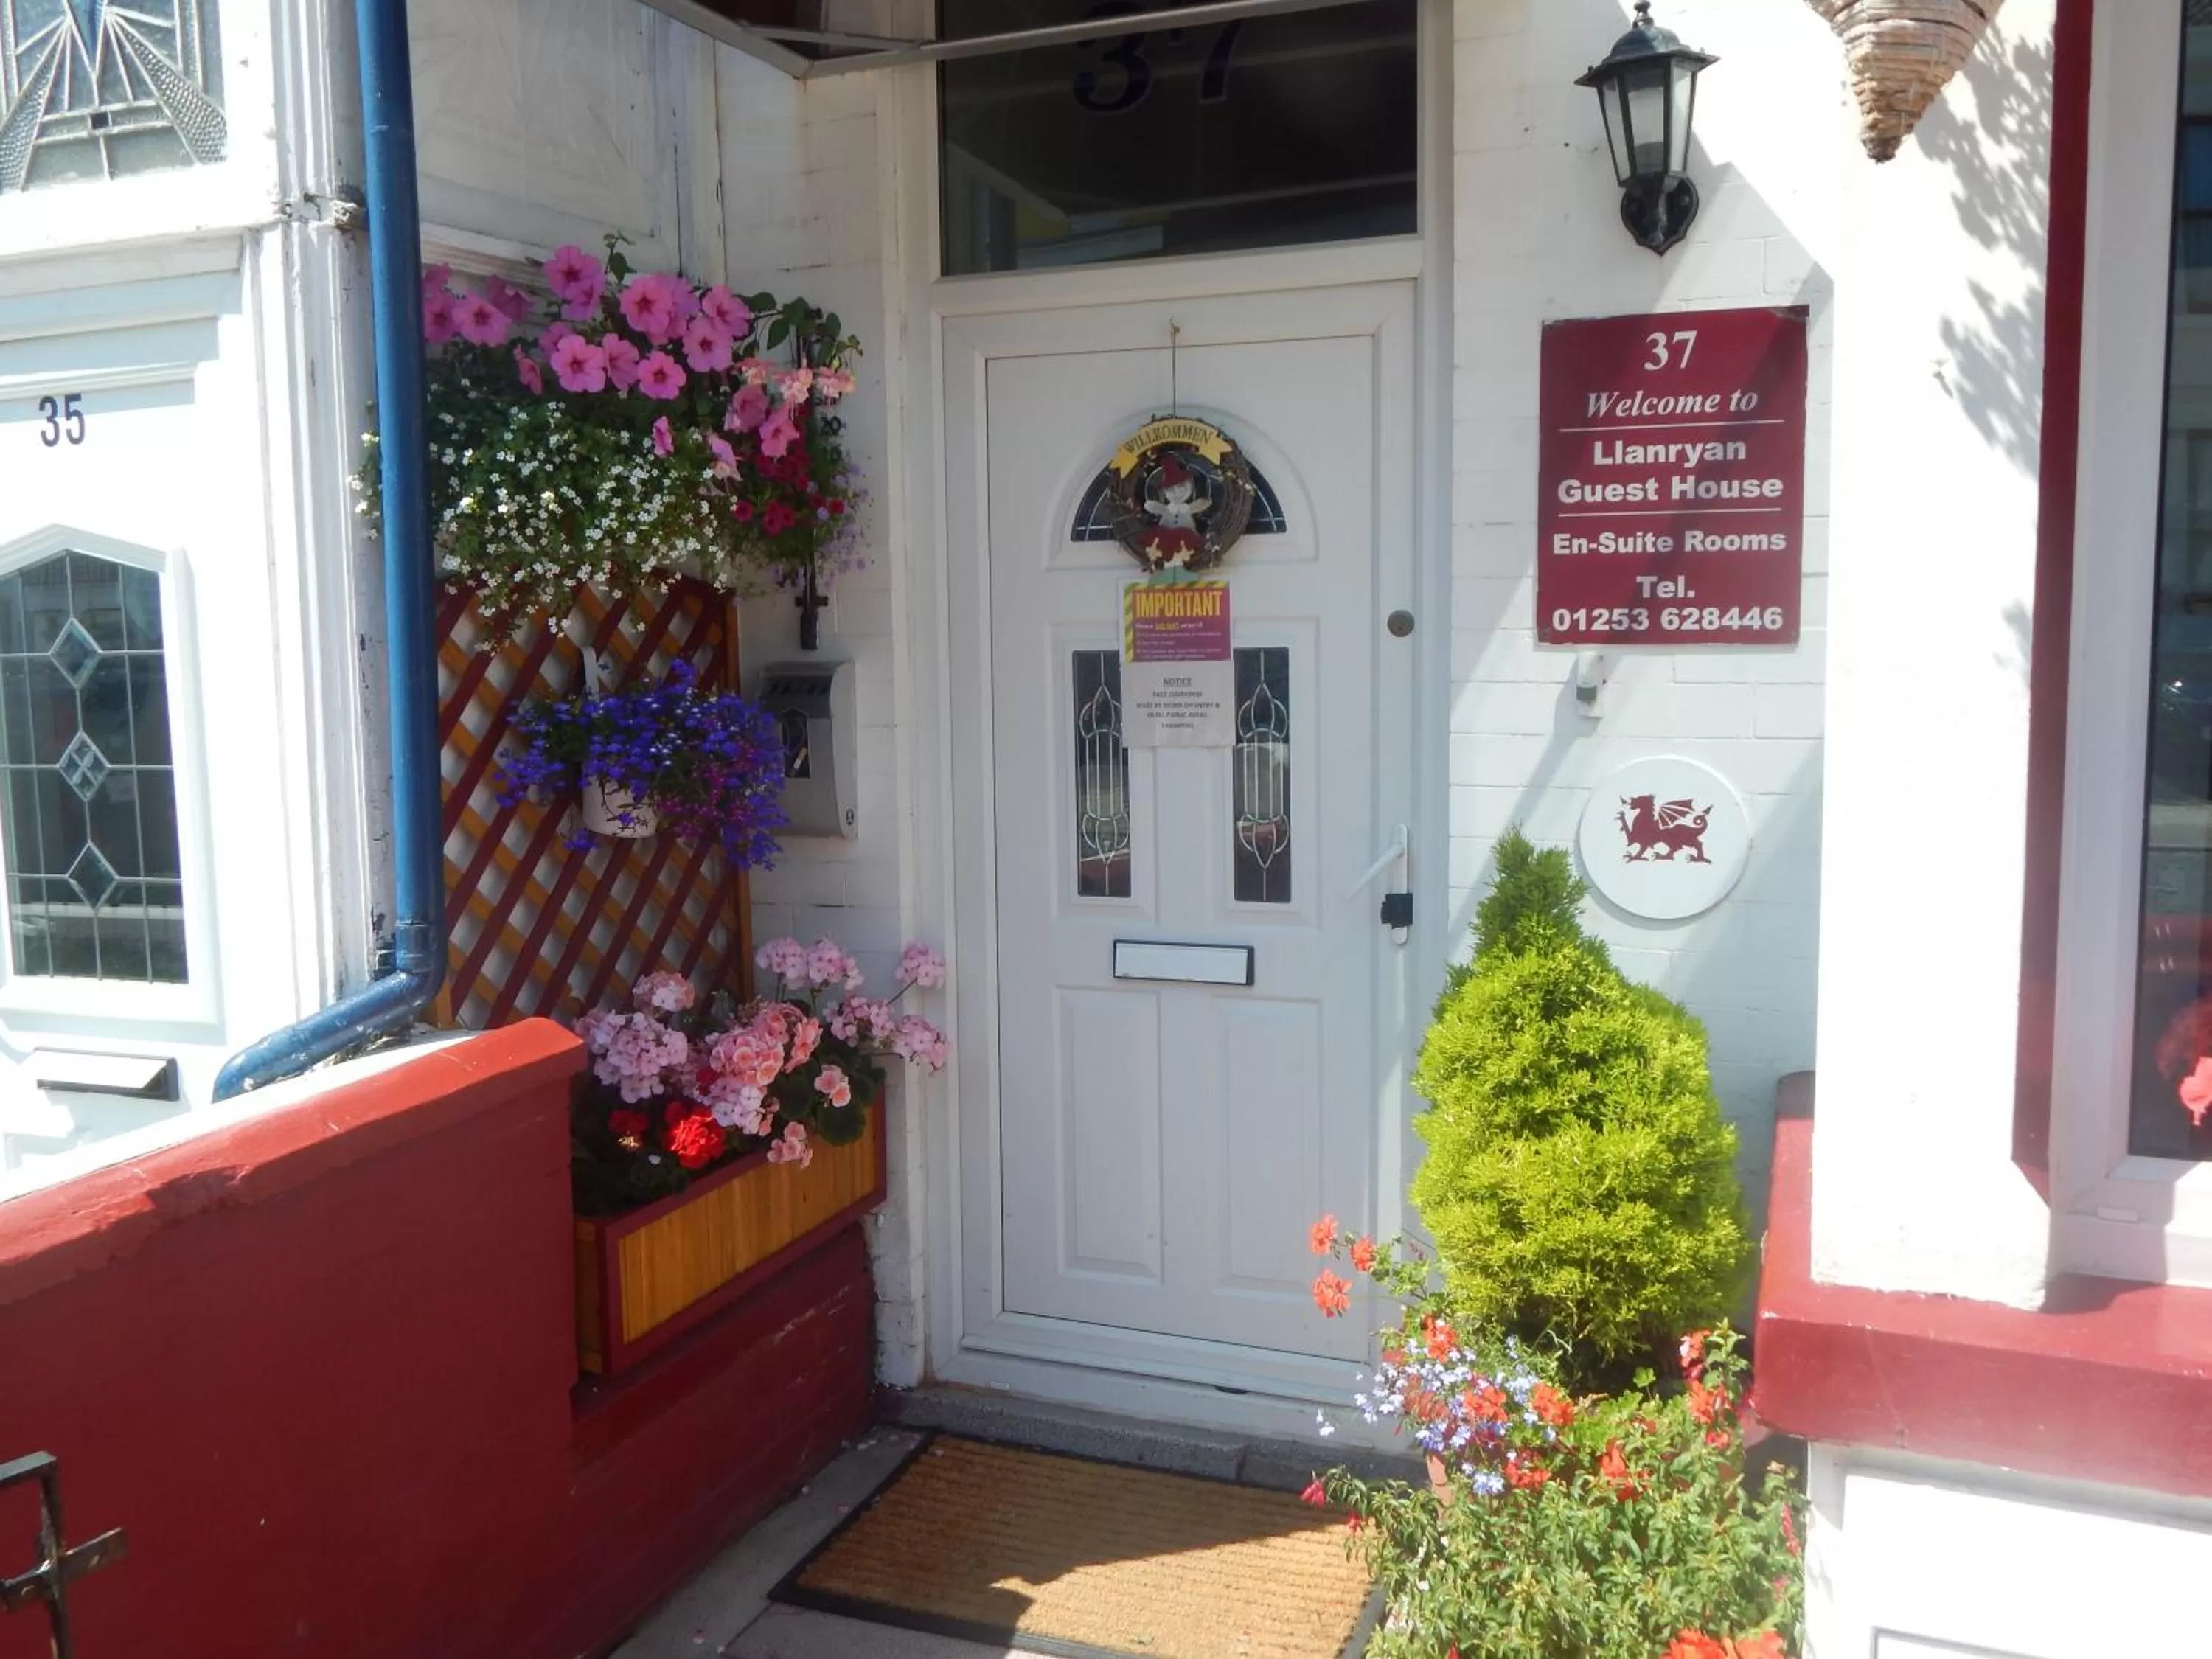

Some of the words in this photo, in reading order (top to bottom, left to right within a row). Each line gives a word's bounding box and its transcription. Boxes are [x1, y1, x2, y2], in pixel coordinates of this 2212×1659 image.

[1644, 330, 1697, 370] 37
[1587, 389, 1721, 418] Welcome
[1729, 389, 1758, 411] to
[38, 392, 86, 448] 35
[1123, 424, 1213, 453] WILLKOMMEN
[1593, 440, 1746, 468] Llanryan
[1557, 476, 1658, 504] Guest
[1671, 475, 1784, 500] House
[1553, 532, 1674, 554] En-Suite
[1684, 529, 1787, 552] Rooms
[1636, 575, 1696, 598] Tel.
[1135, 591, 1222, 618] IMPORTANT
[1551, 608, 1649, 632] 01253
[1660, 606, 1784, 630] 628446
[1163, 678, 1192, 686] NOTICE
